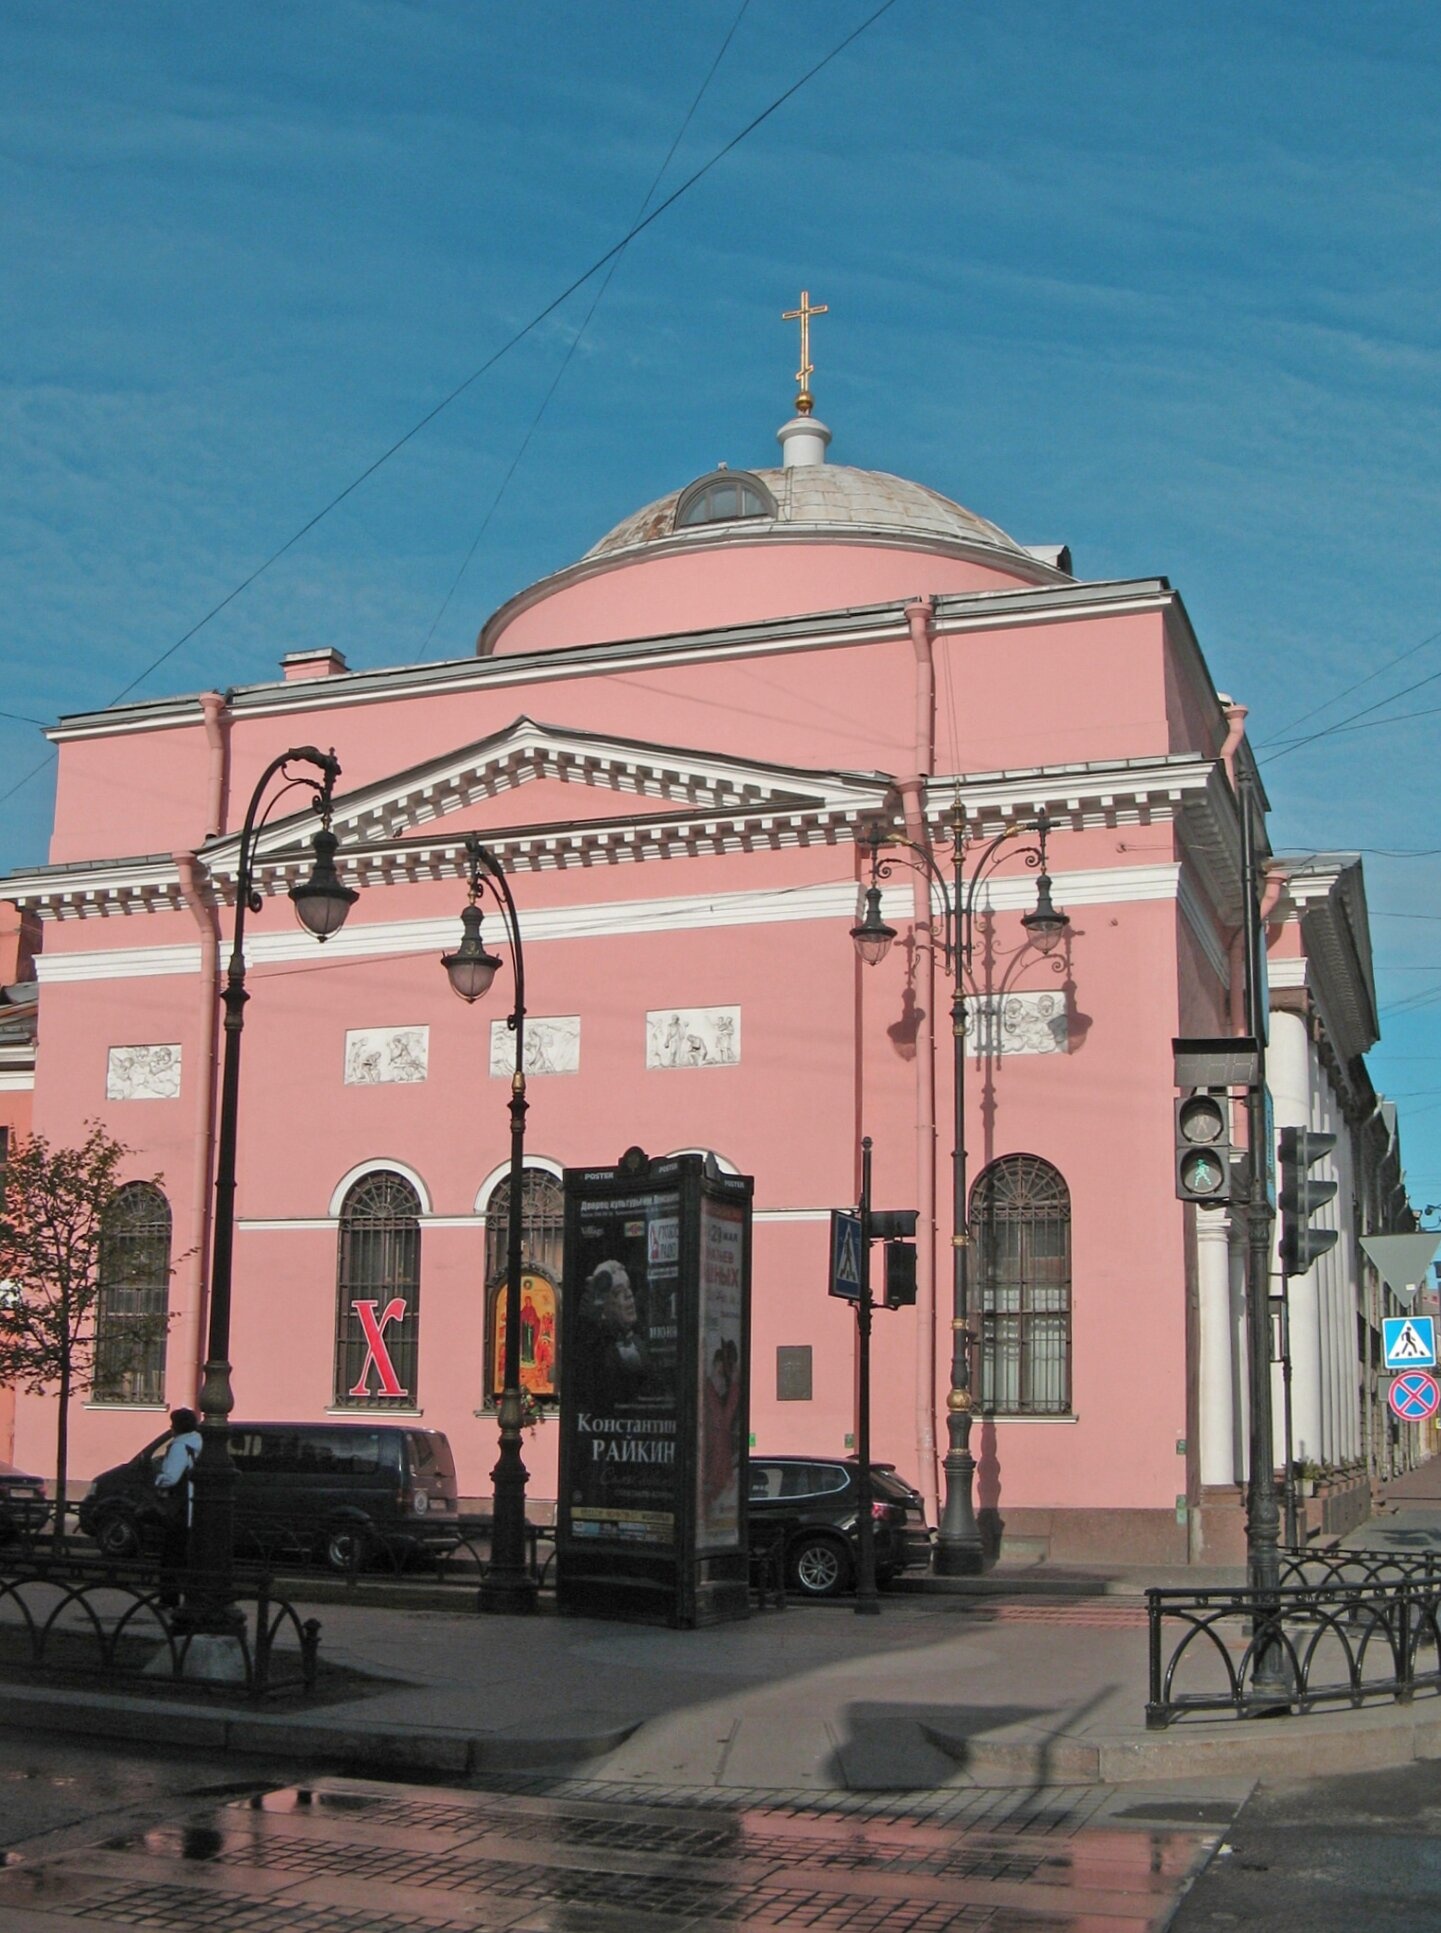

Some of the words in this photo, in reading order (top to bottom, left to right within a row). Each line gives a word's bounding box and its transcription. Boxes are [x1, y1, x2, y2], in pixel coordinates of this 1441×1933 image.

[658, 1163, 679, 1173] POSTER
[584, 1172, 614, 1180] POSTER
[577, 1413, 677, 1434] Константин
[592, 1435, 675, 1463] РАЙКИН
